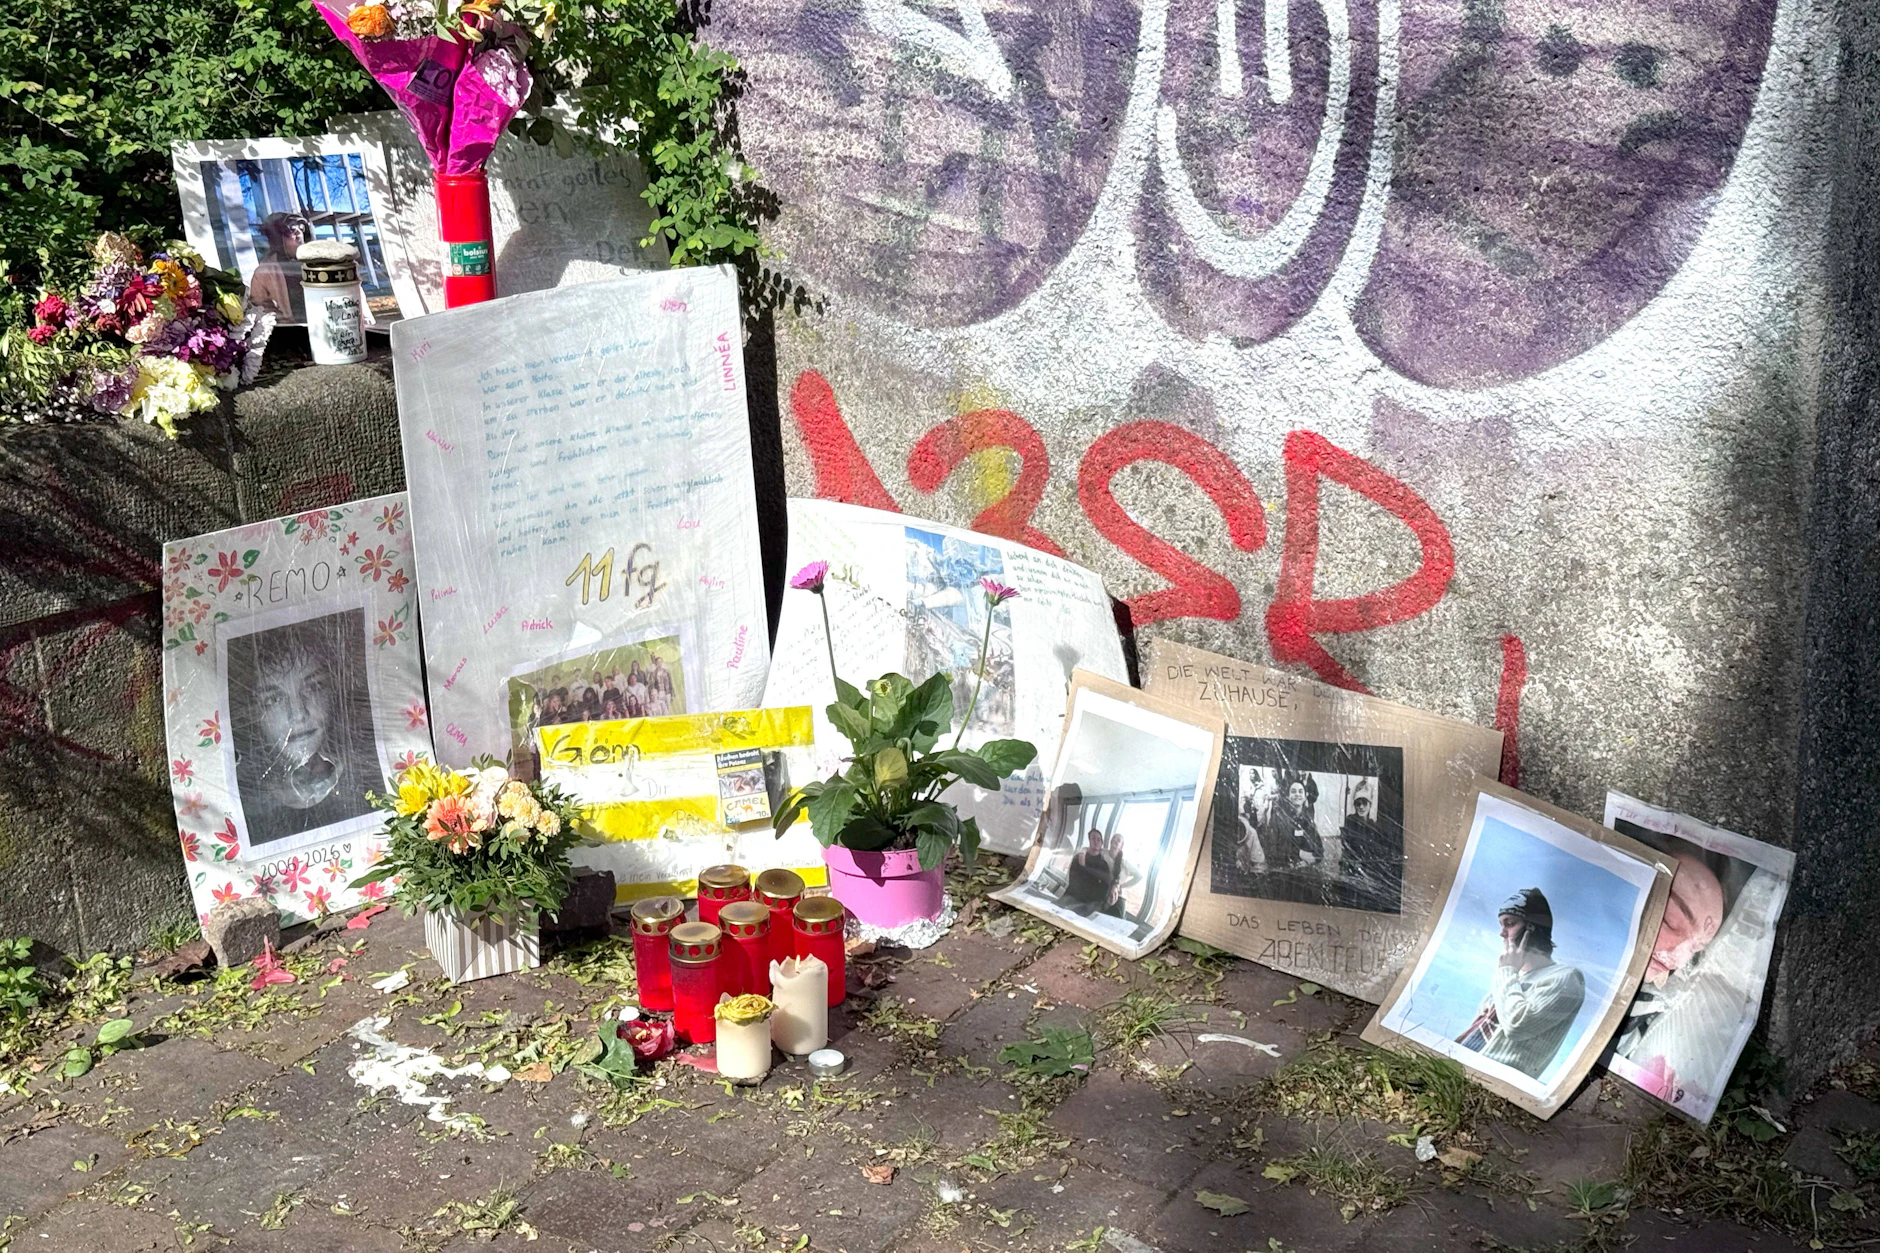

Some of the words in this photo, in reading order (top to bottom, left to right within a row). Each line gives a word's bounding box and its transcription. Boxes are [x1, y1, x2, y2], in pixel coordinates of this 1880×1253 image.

[463, 246, 489, 257] bolsius
[712, 331, 736, 391] LINNÉA
[538, 388, 565, 399] Klasse
[673, 473, 724, 494] unglaublich
[676, 514, 701, 530] Lou
[246, 560, 331, 610] REMO
[564, 546, 615, 606] 11
[726, 624, 749, 670] Pauline
[1167, 664, 1194, 681] DIE
[1204, 665, 1251, 682] WELT
[1262, 674, 1297, 693] WAR
[1198, 681, 1299, 711] ZUHAUSE,
[726, 797, 766, 812] CAMEL
[260, 844, 341, 881] 2006-2026
[1227, 913, 1260, 929] DAS
[1277, 919, 1341, 937] LEBEN
